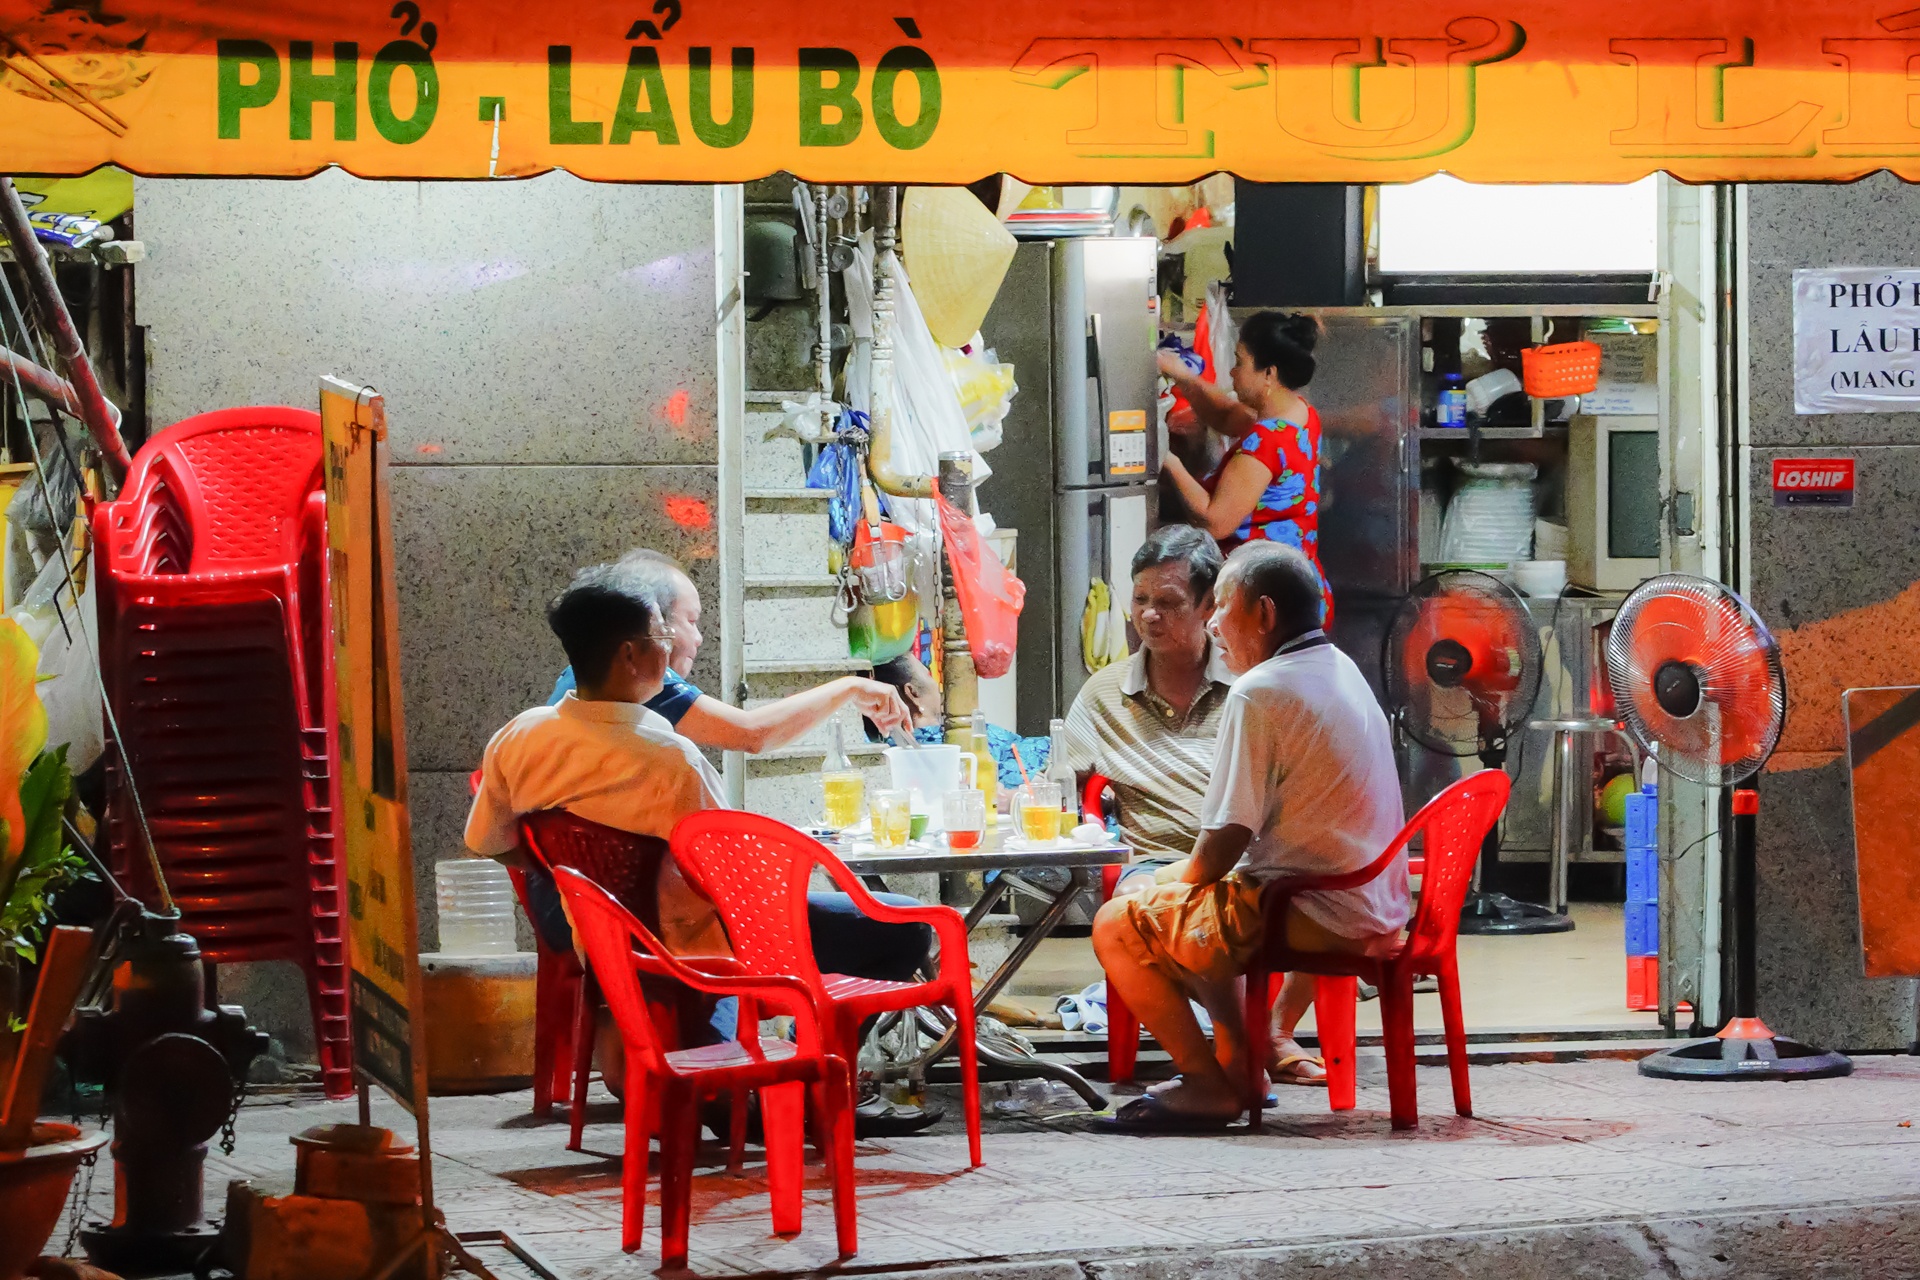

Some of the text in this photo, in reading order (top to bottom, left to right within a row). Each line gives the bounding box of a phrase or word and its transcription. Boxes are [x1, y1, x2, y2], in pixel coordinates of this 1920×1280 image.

[217, 1, 440, 144] PHỞ
[548, 0, 755, 149] LẨU
[798, 17, 942, 150] BÒ
[1829, 275, 1902, 308] PHỞ
[1831, 369, 1915, 393] (MANG
[1777, 470, 1849, 487] LOSHIP
